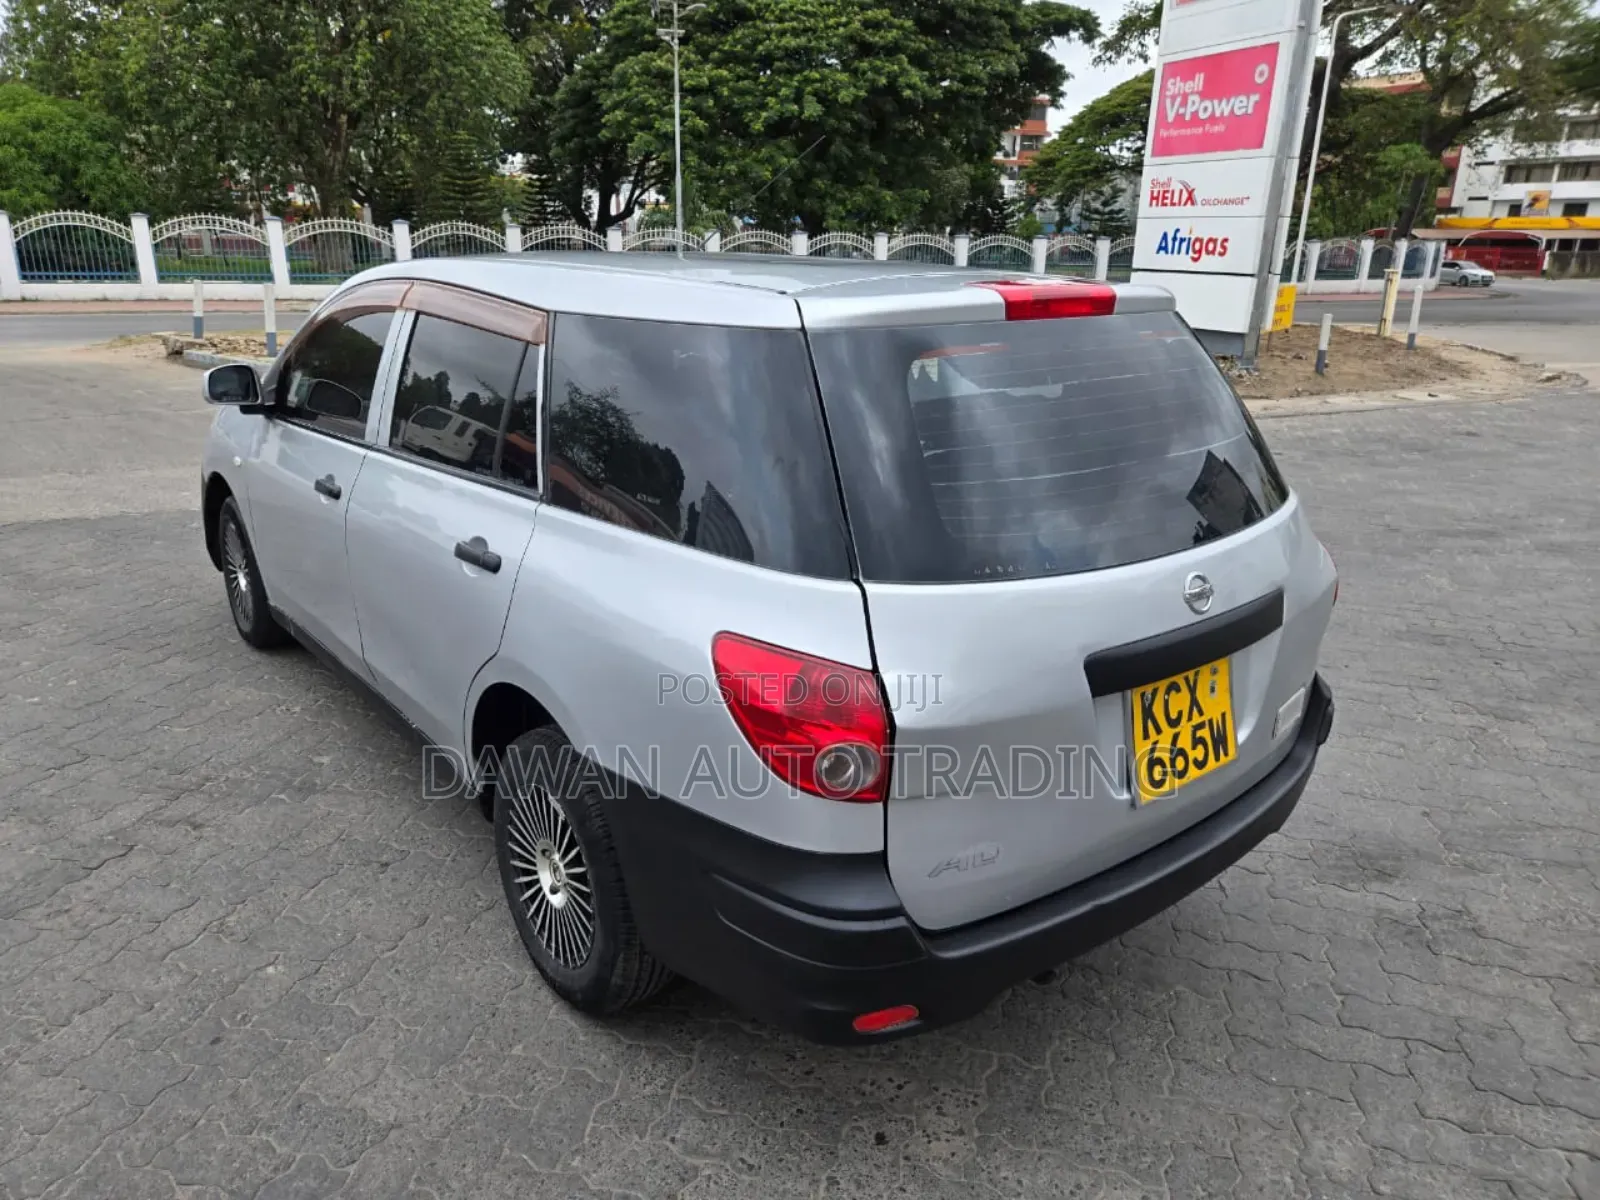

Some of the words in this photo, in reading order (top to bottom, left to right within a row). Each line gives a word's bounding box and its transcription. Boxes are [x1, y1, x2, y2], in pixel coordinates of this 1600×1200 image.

[1166, 73, 1204, 96] Shell
[1165, 92, 1260, 123] V-Power
[1149, 187, 1197, 208] HELIX
[1150, 177, 1172, 190] Shell
[1156, 227, 1230, 263] Afrigas
[1139, 669, 1205, 741] KCX
[1146, 711, 1230, 790] 665W
